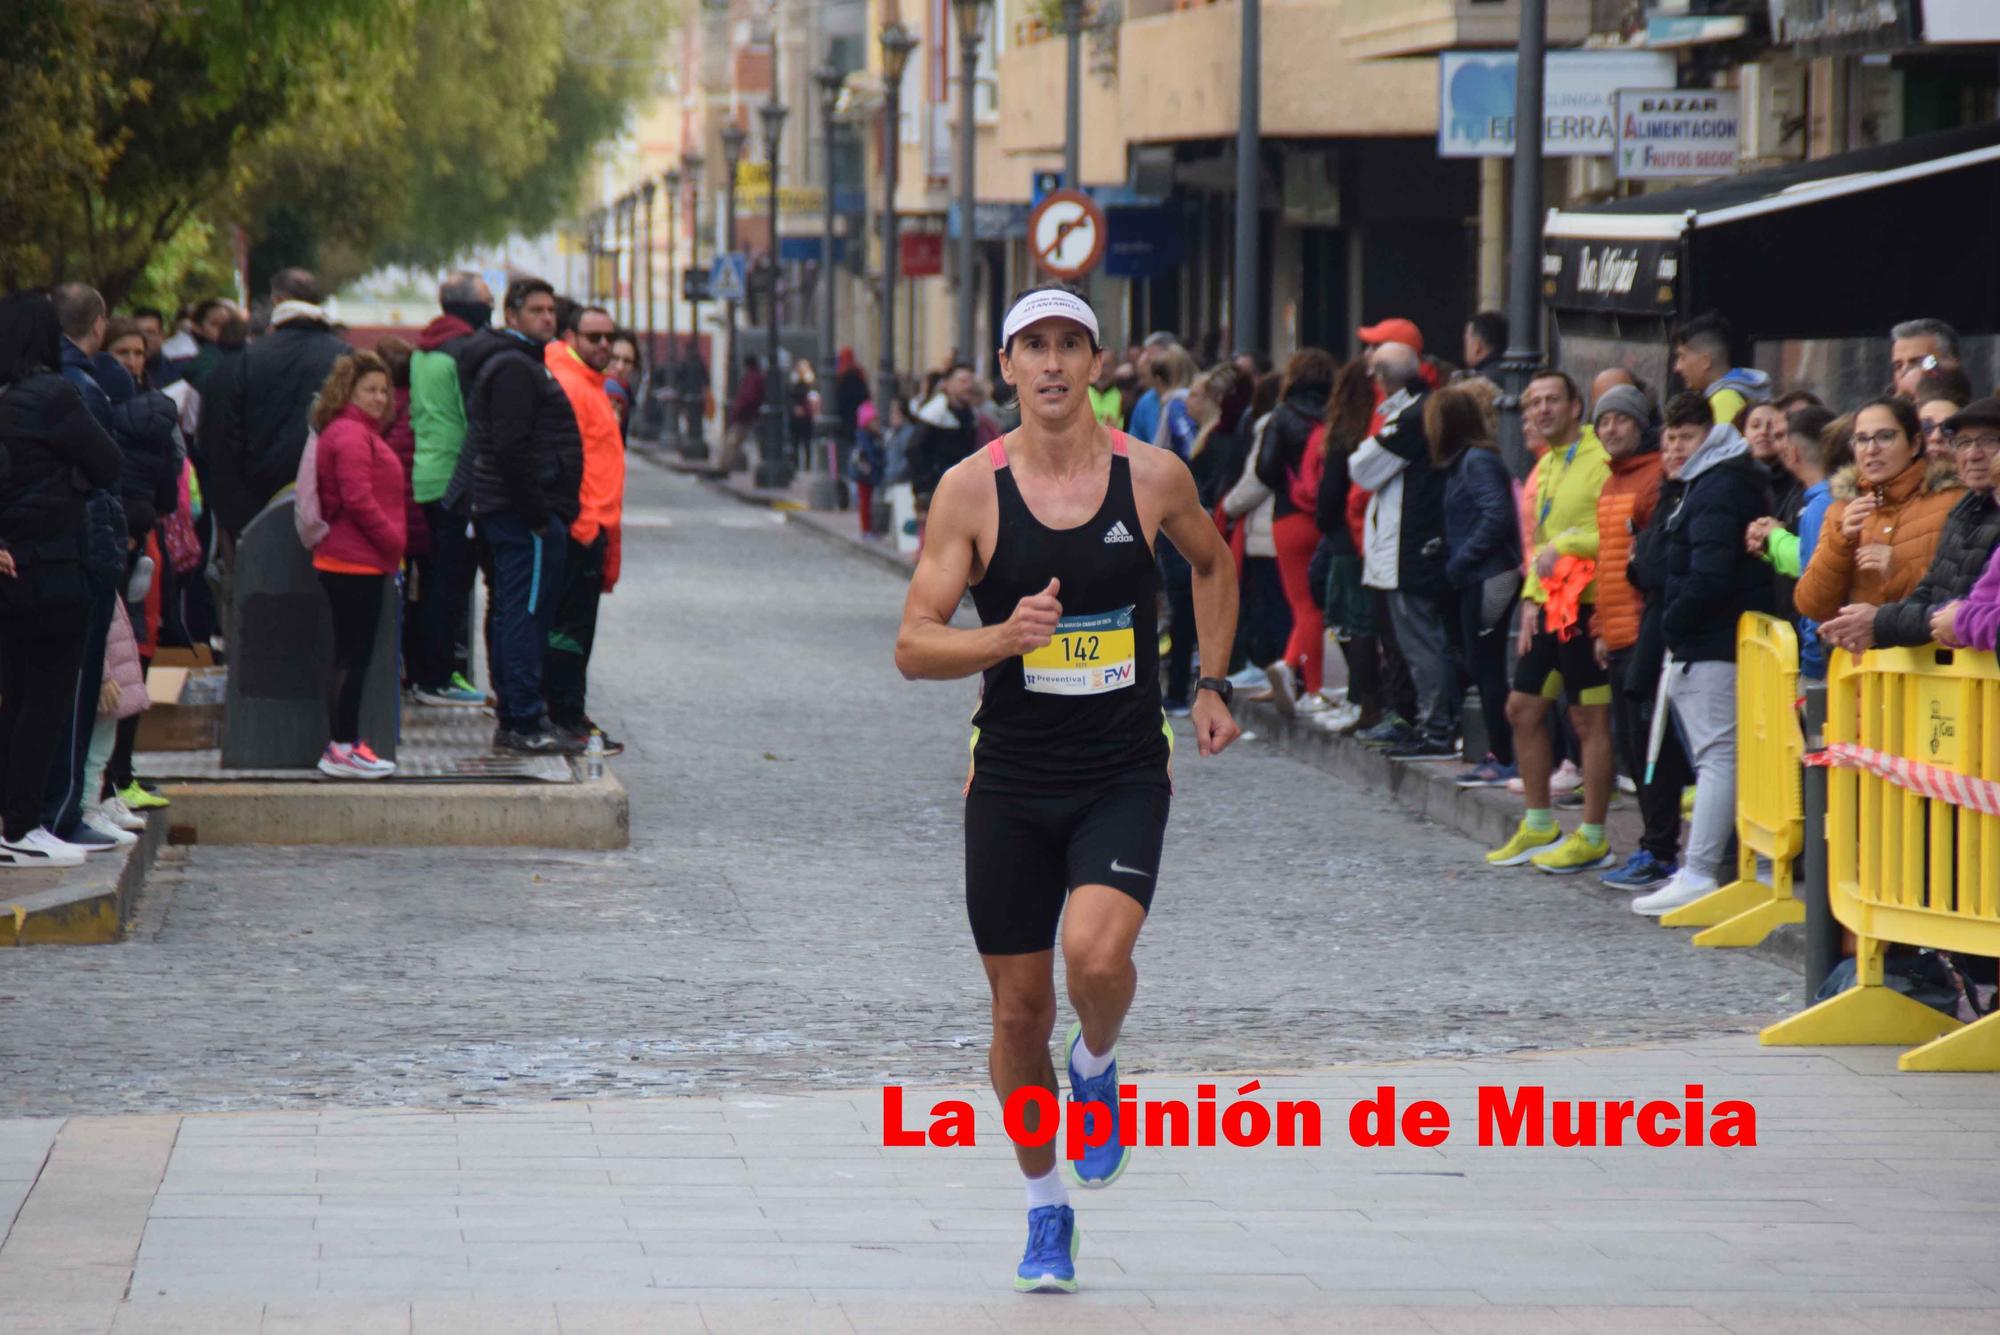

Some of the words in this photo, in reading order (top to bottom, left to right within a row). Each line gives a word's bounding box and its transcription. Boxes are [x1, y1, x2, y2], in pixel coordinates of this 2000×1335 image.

[1640, 98, 1717, 113] BAZAR
[1624, 147, 1636, 167] Y
[1104, 534, 1134, 544] adidas
[1061, 636, 1100, 662] 142
[1037, 674, 1082, 684] Preventiva
